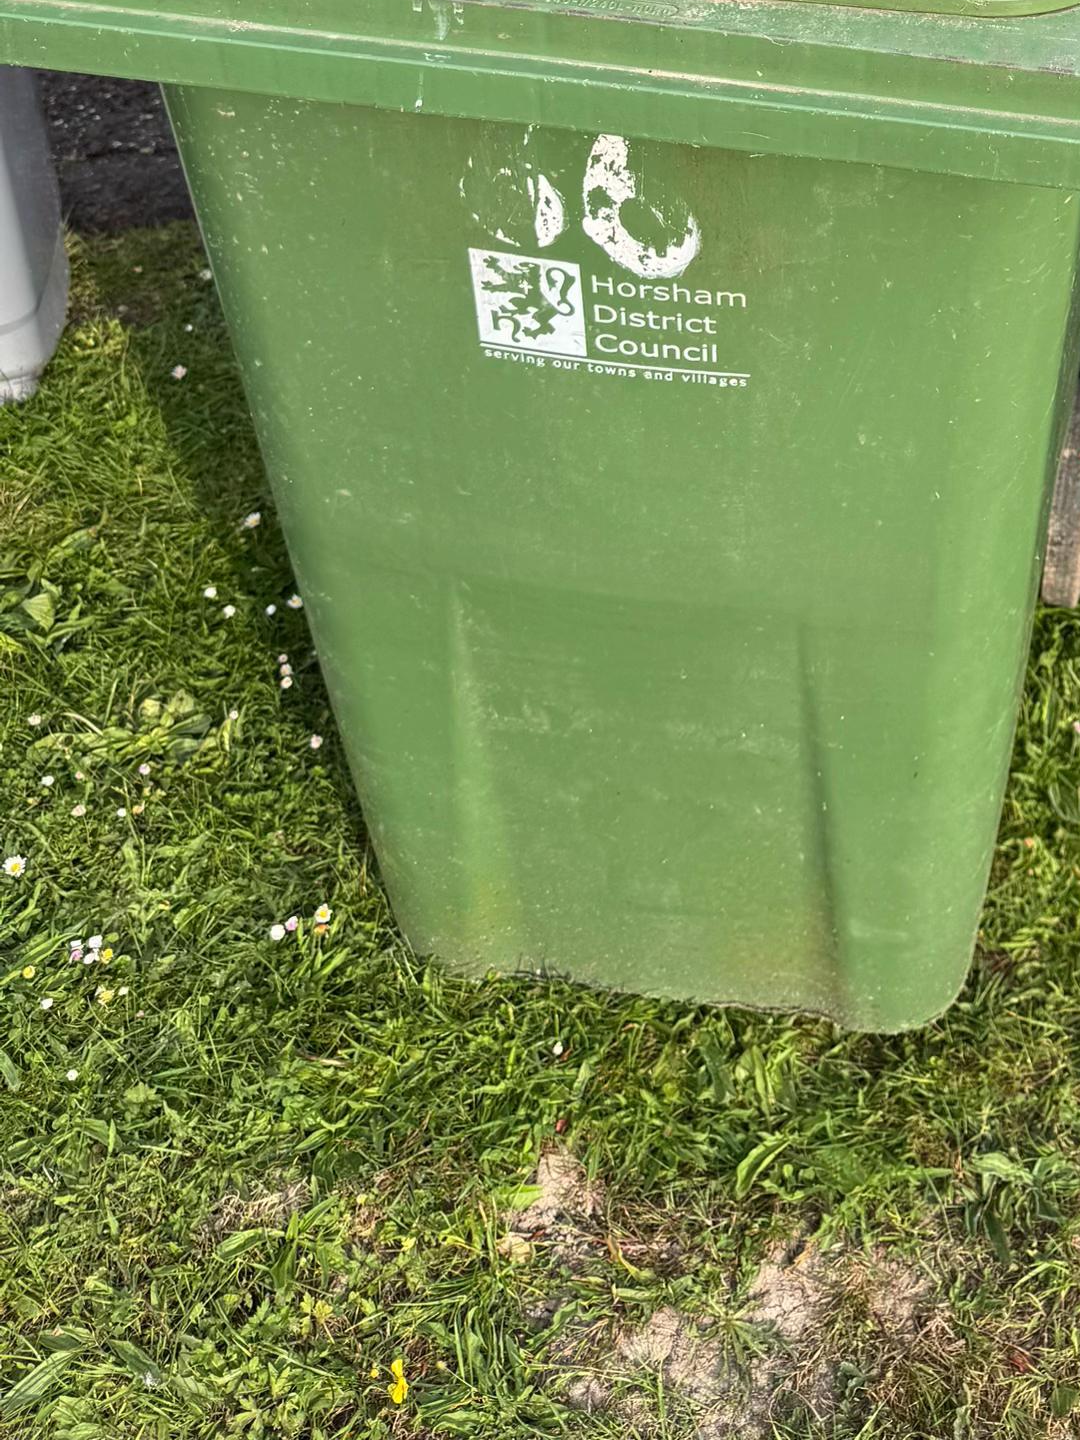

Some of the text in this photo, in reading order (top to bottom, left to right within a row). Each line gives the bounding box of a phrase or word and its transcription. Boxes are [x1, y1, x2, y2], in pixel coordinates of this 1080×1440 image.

[590, 273, 748, 309] Horsham
[591, 303, 718, 335] District
[593, 334, 719, 364] Council
[483, 348, 749, 389] serving our towns and villages
